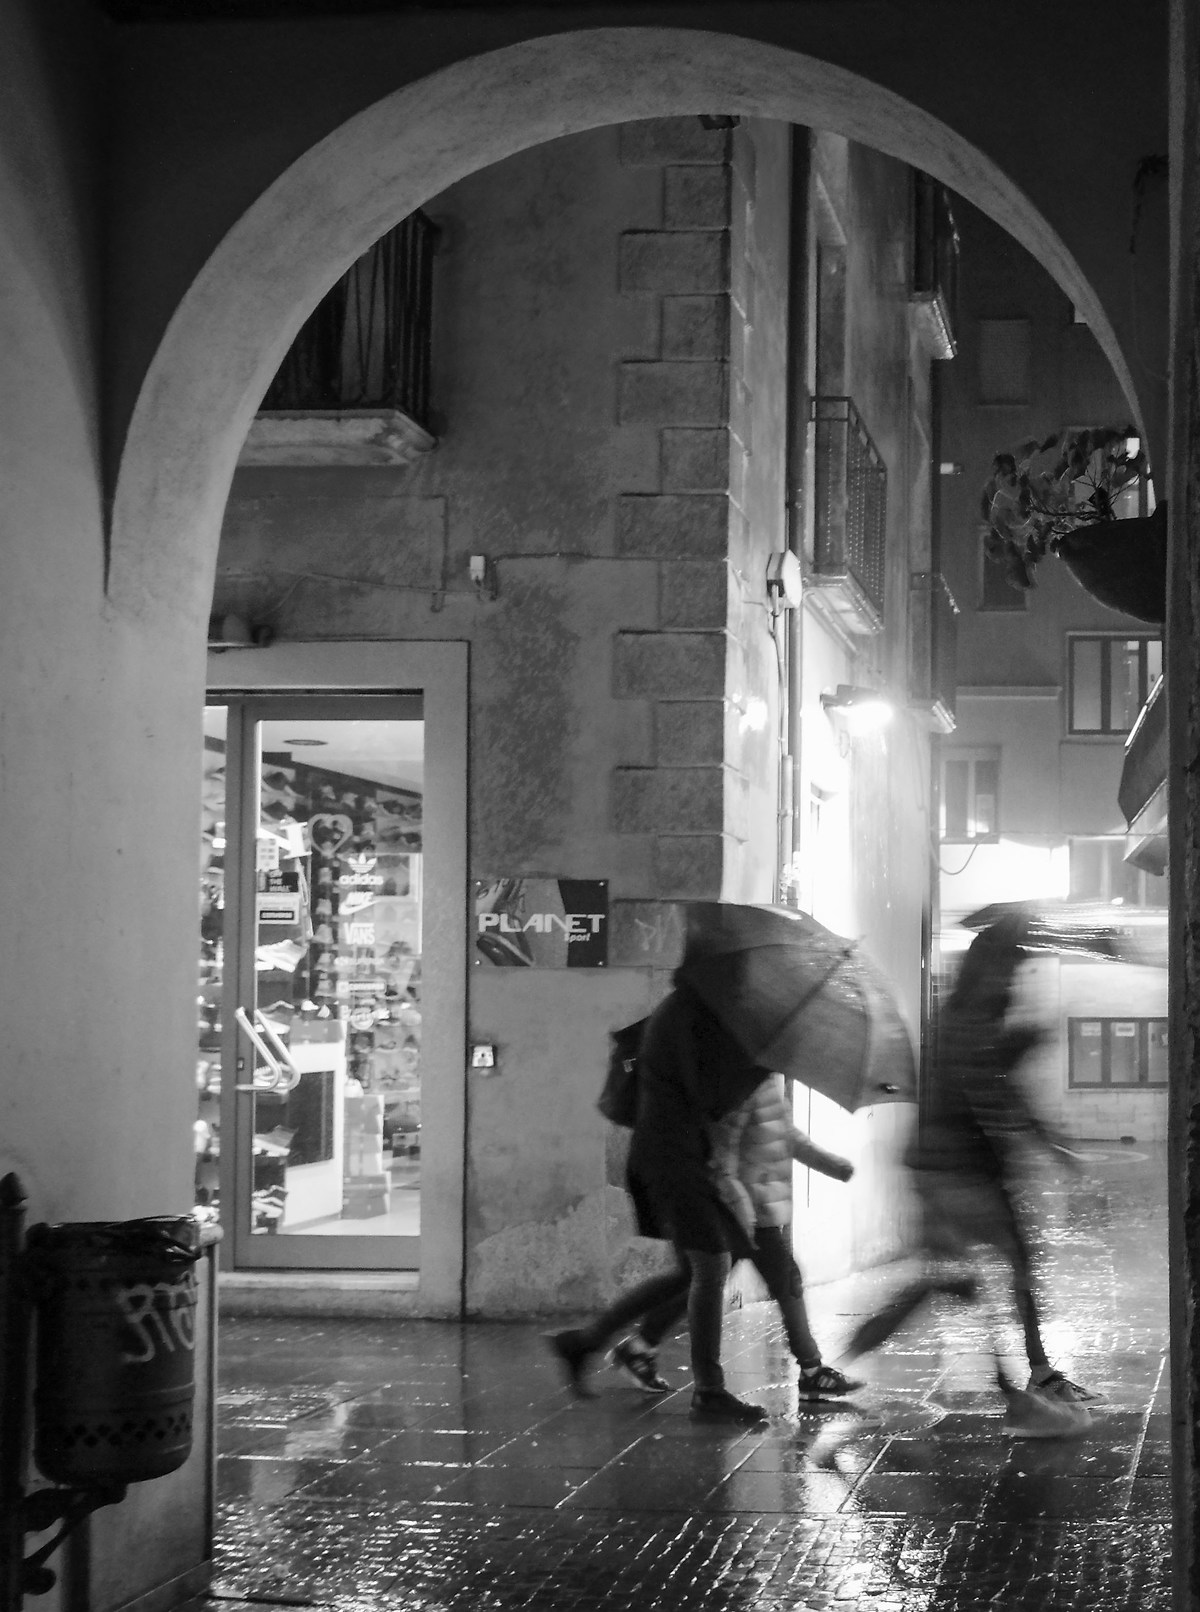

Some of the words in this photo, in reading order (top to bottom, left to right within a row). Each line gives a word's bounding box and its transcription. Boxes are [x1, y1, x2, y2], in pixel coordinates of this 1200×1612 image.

[339, 873, 384, 886] adidas
[478, 912, 606, 934] PLANET
[343, 922, 375, 945] VANS
[564, 932, 591, 943] Sport
